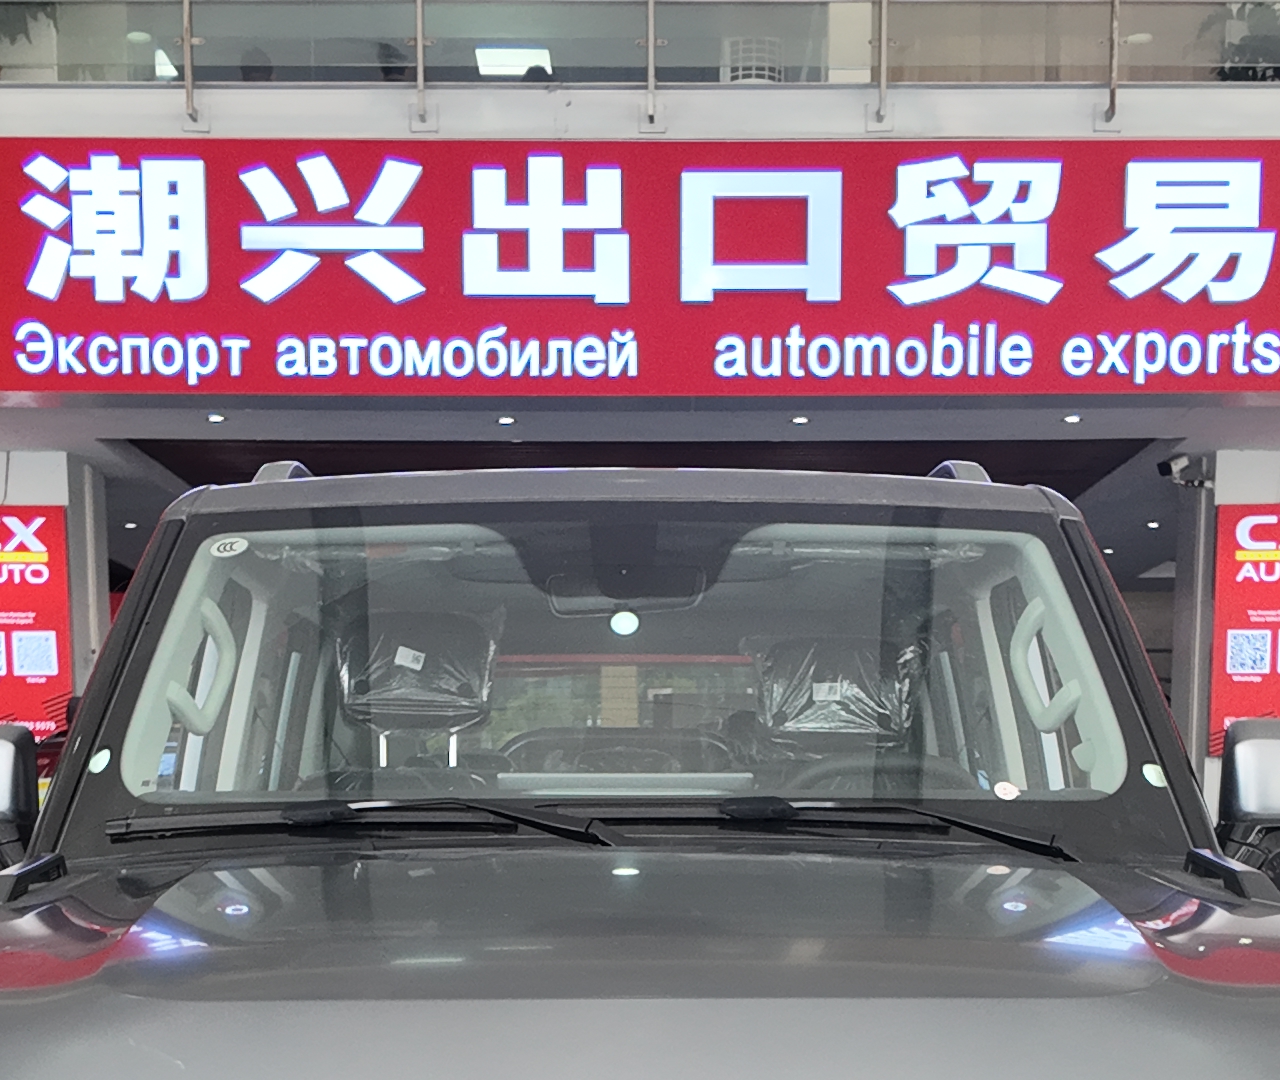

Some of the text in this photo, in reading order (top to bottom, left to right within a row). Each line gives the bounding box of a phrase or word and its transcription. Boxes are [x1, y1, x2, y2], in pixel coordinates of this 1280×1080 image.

[21, 155, 1276, 306] 潮兴出口贸易
[14, 321, 638, 386] Экспорт автомобилей
[713, 323, 1033, 378] automobile
